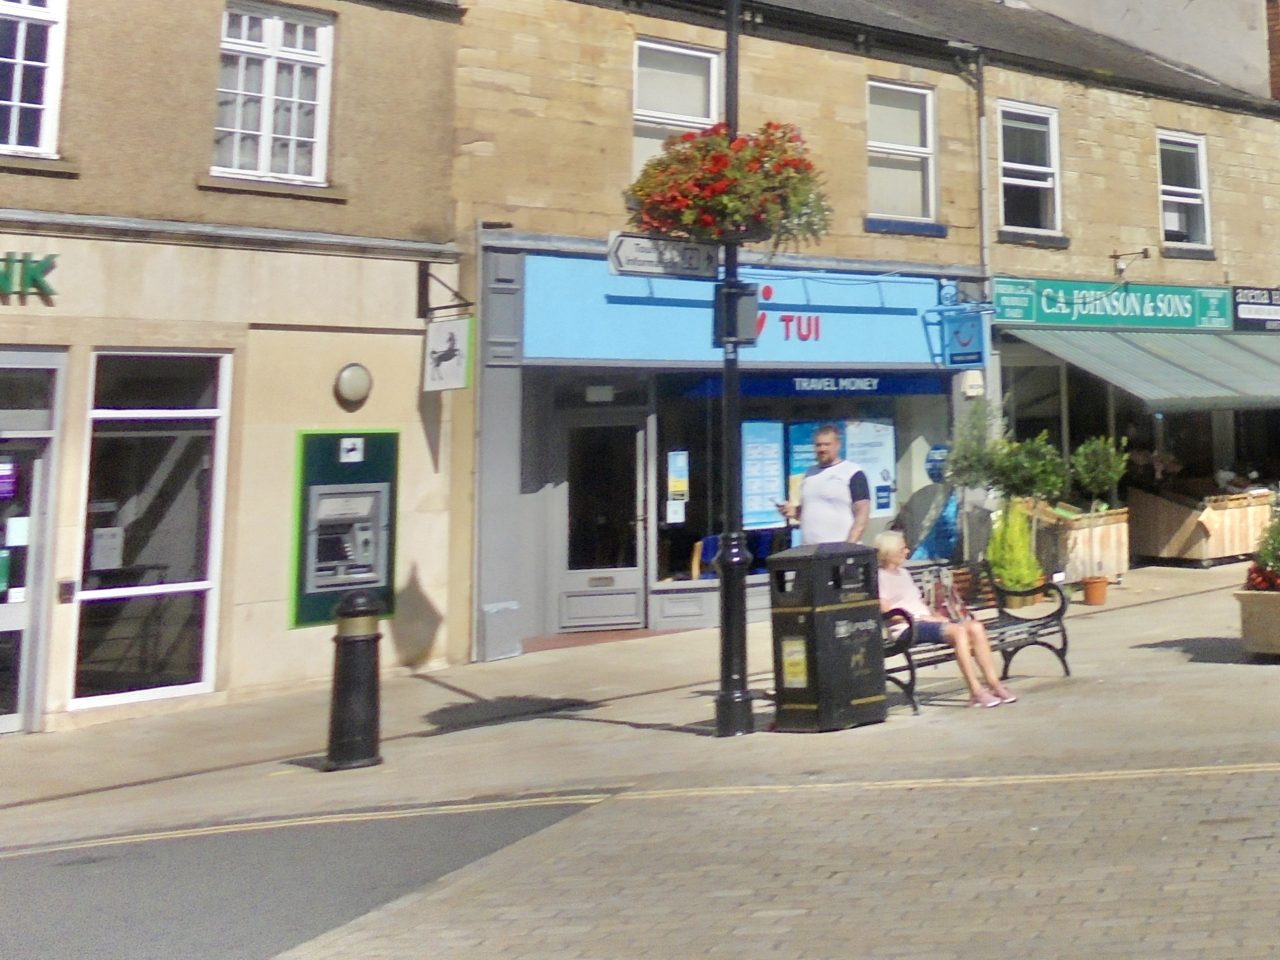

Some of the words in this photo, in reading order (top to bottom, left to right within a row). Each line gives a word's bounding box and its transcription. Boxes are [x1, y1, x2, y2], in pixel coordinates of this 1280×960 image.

[1071, 290, 1141, 320] JOHNSON
[1142, 294, 1155, 317] &
[1156, 294, 1193, 318] SONS
[780, 315, 819, 341] TUI
[794, 378, 837, 391] TRAVEL
[838, 378, 879, 390] MONEY
